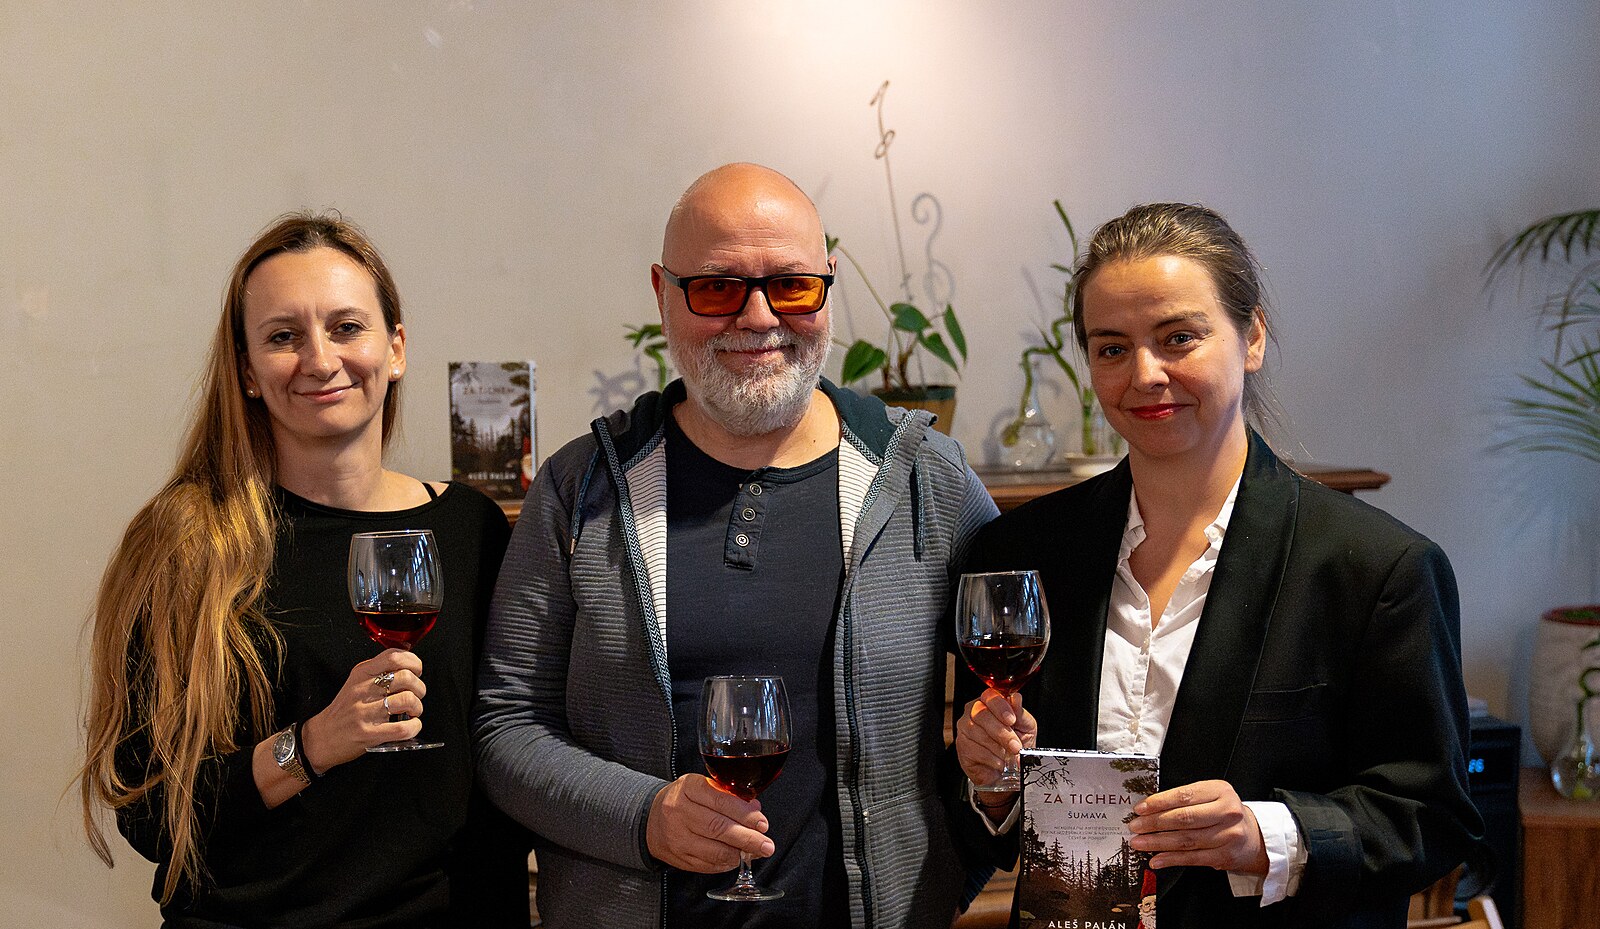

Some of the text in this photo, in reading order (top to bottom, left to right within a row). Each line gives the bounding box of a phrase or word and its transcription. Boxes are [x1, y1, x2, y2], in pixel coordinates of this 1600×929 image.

[1043, 793, 1132, 805] ZA TICHEM
[1067, 811, 1108, 820] ŠUMAVA
[1048, 918, 1126, 929] ALEŠ PALÁN
